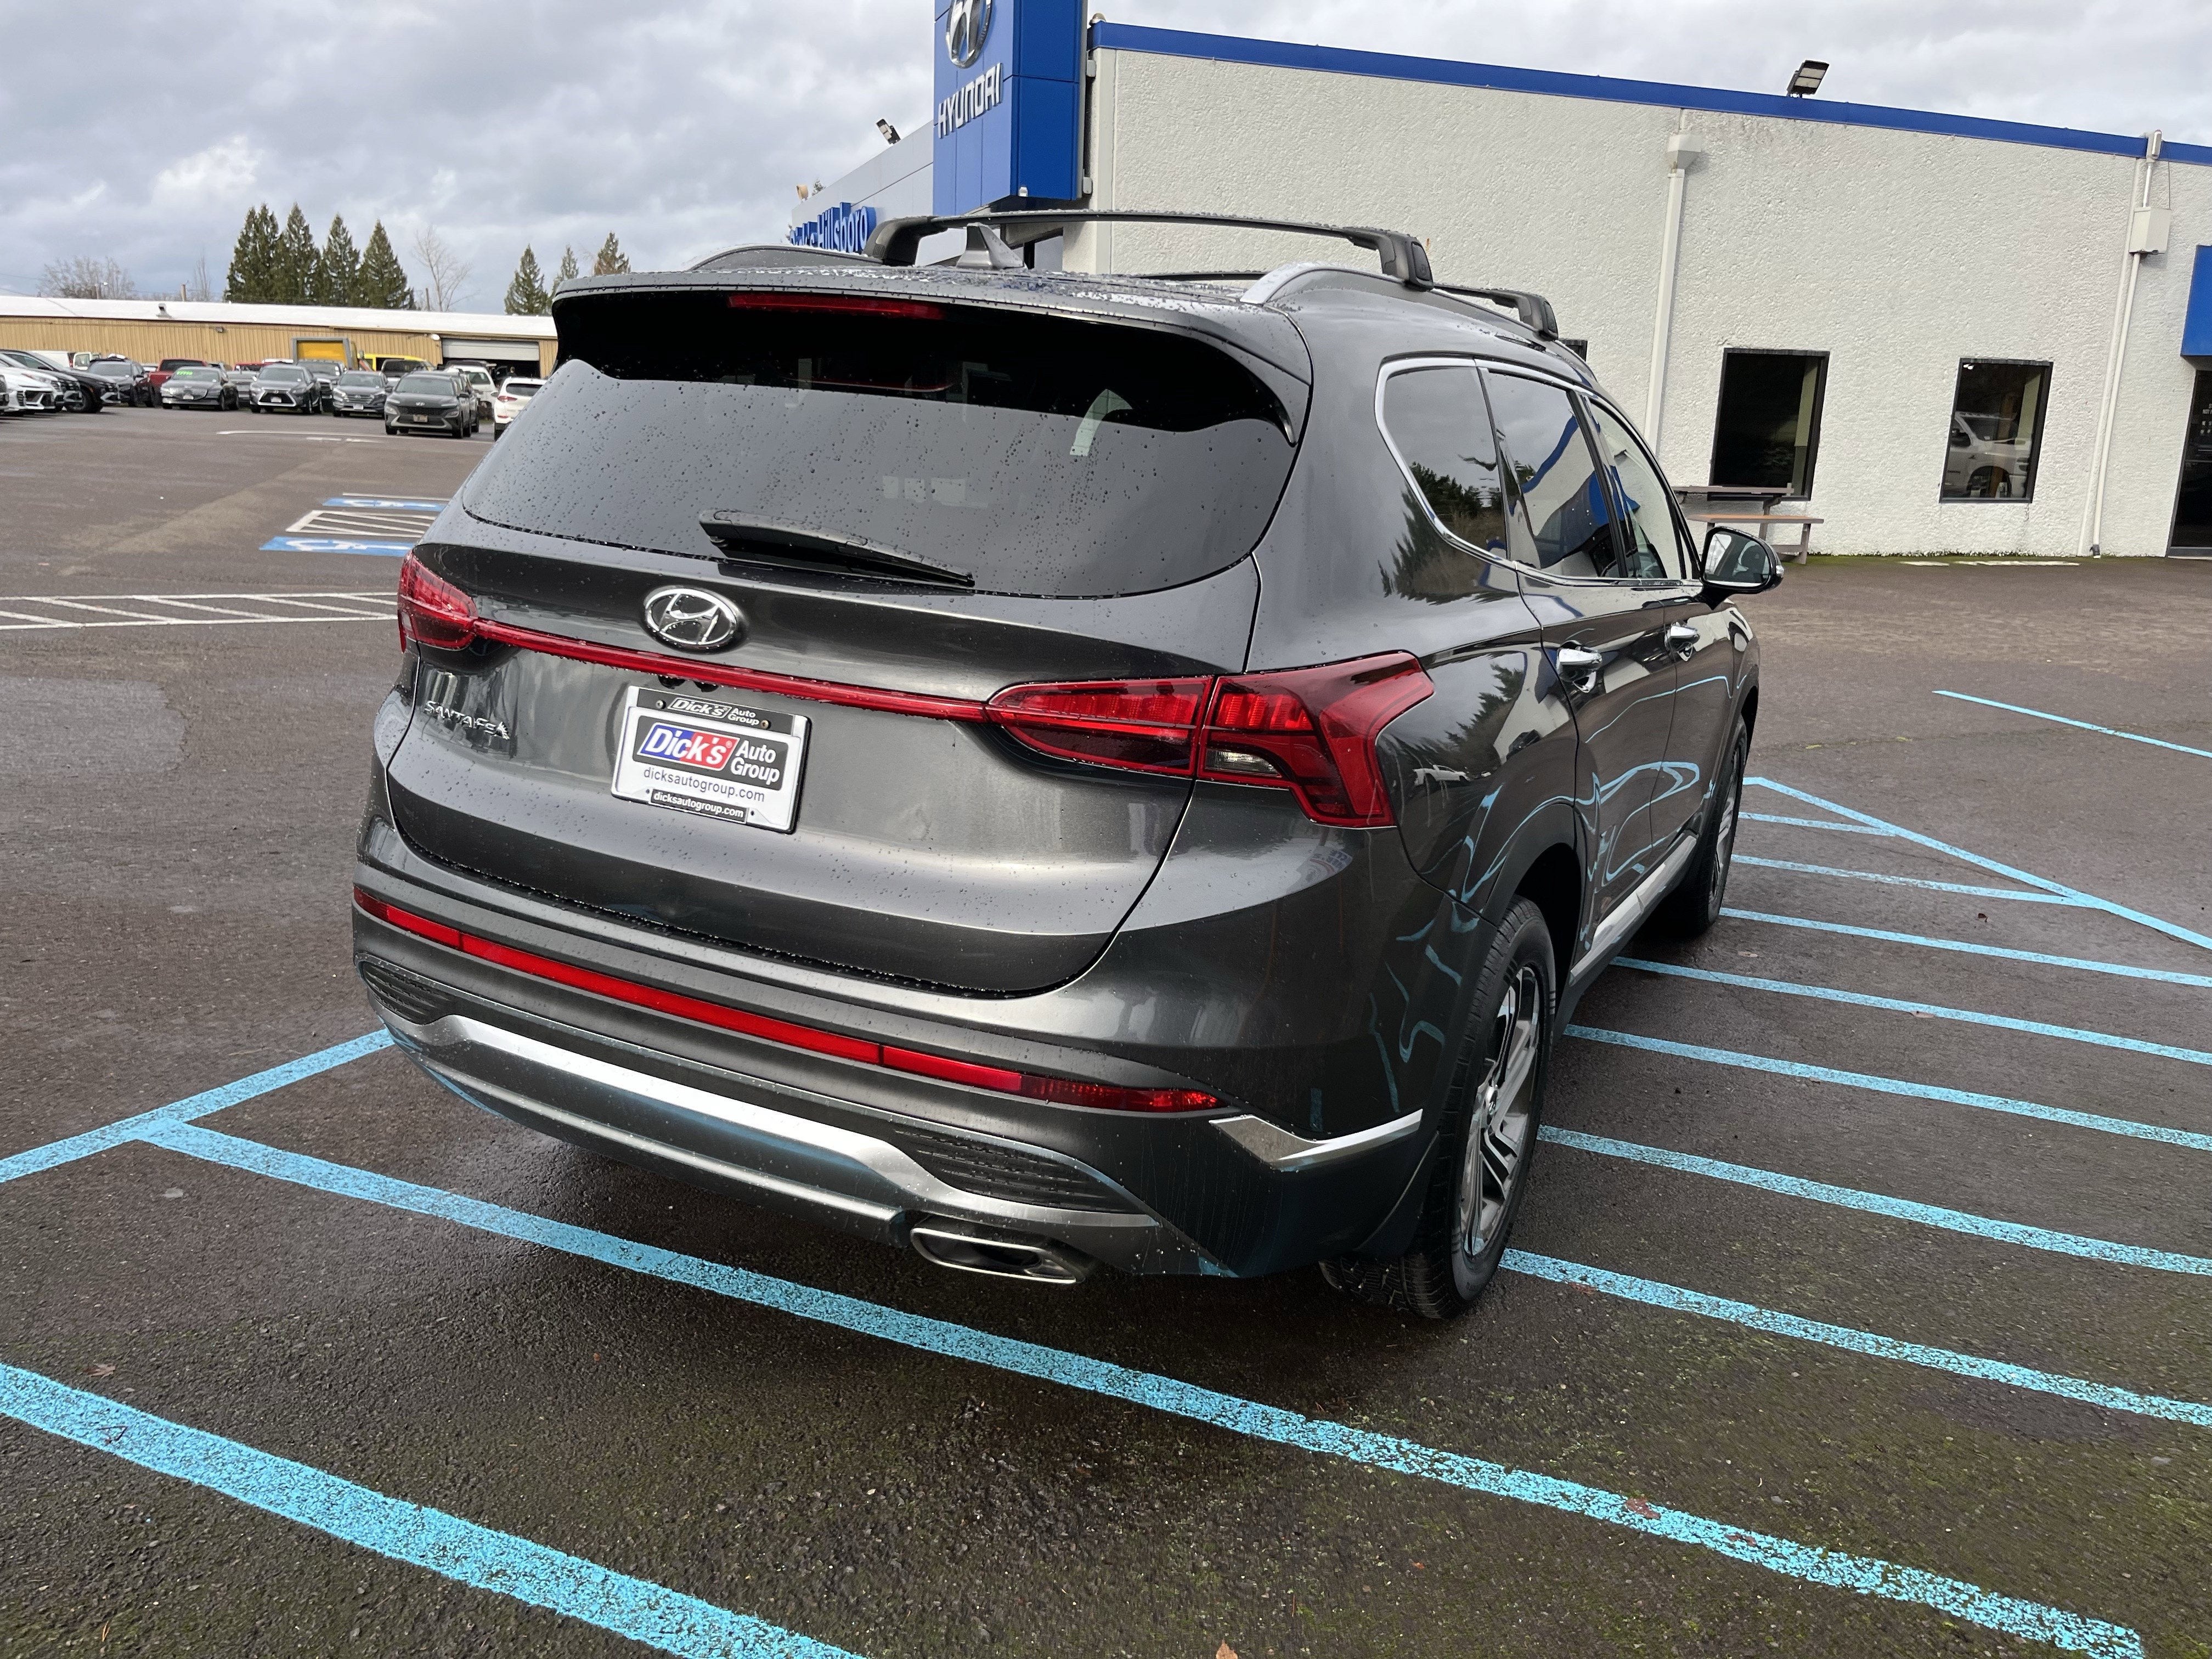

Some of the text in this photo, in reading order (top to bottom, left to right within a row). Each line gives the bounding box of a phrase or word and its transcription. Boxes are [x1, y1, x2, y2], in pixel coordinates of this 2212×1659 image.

[938, 63, 1001, 139] HYUNDAI
[817, 202, 870, 253] Hillsboro
[672, 699, 725, 716] Dick's
[727, 714, 759, 725] Group
[731, 708, 756, 718] Auto
[645, 727, 727, 765] Dick's
[736, 740, 776, 763] Auto
[644, 767, 765, 802] dicksautogroup.com
[730, 757, 780, 785] Group
[653, 791, 744, 818] dicksautogroup.com
